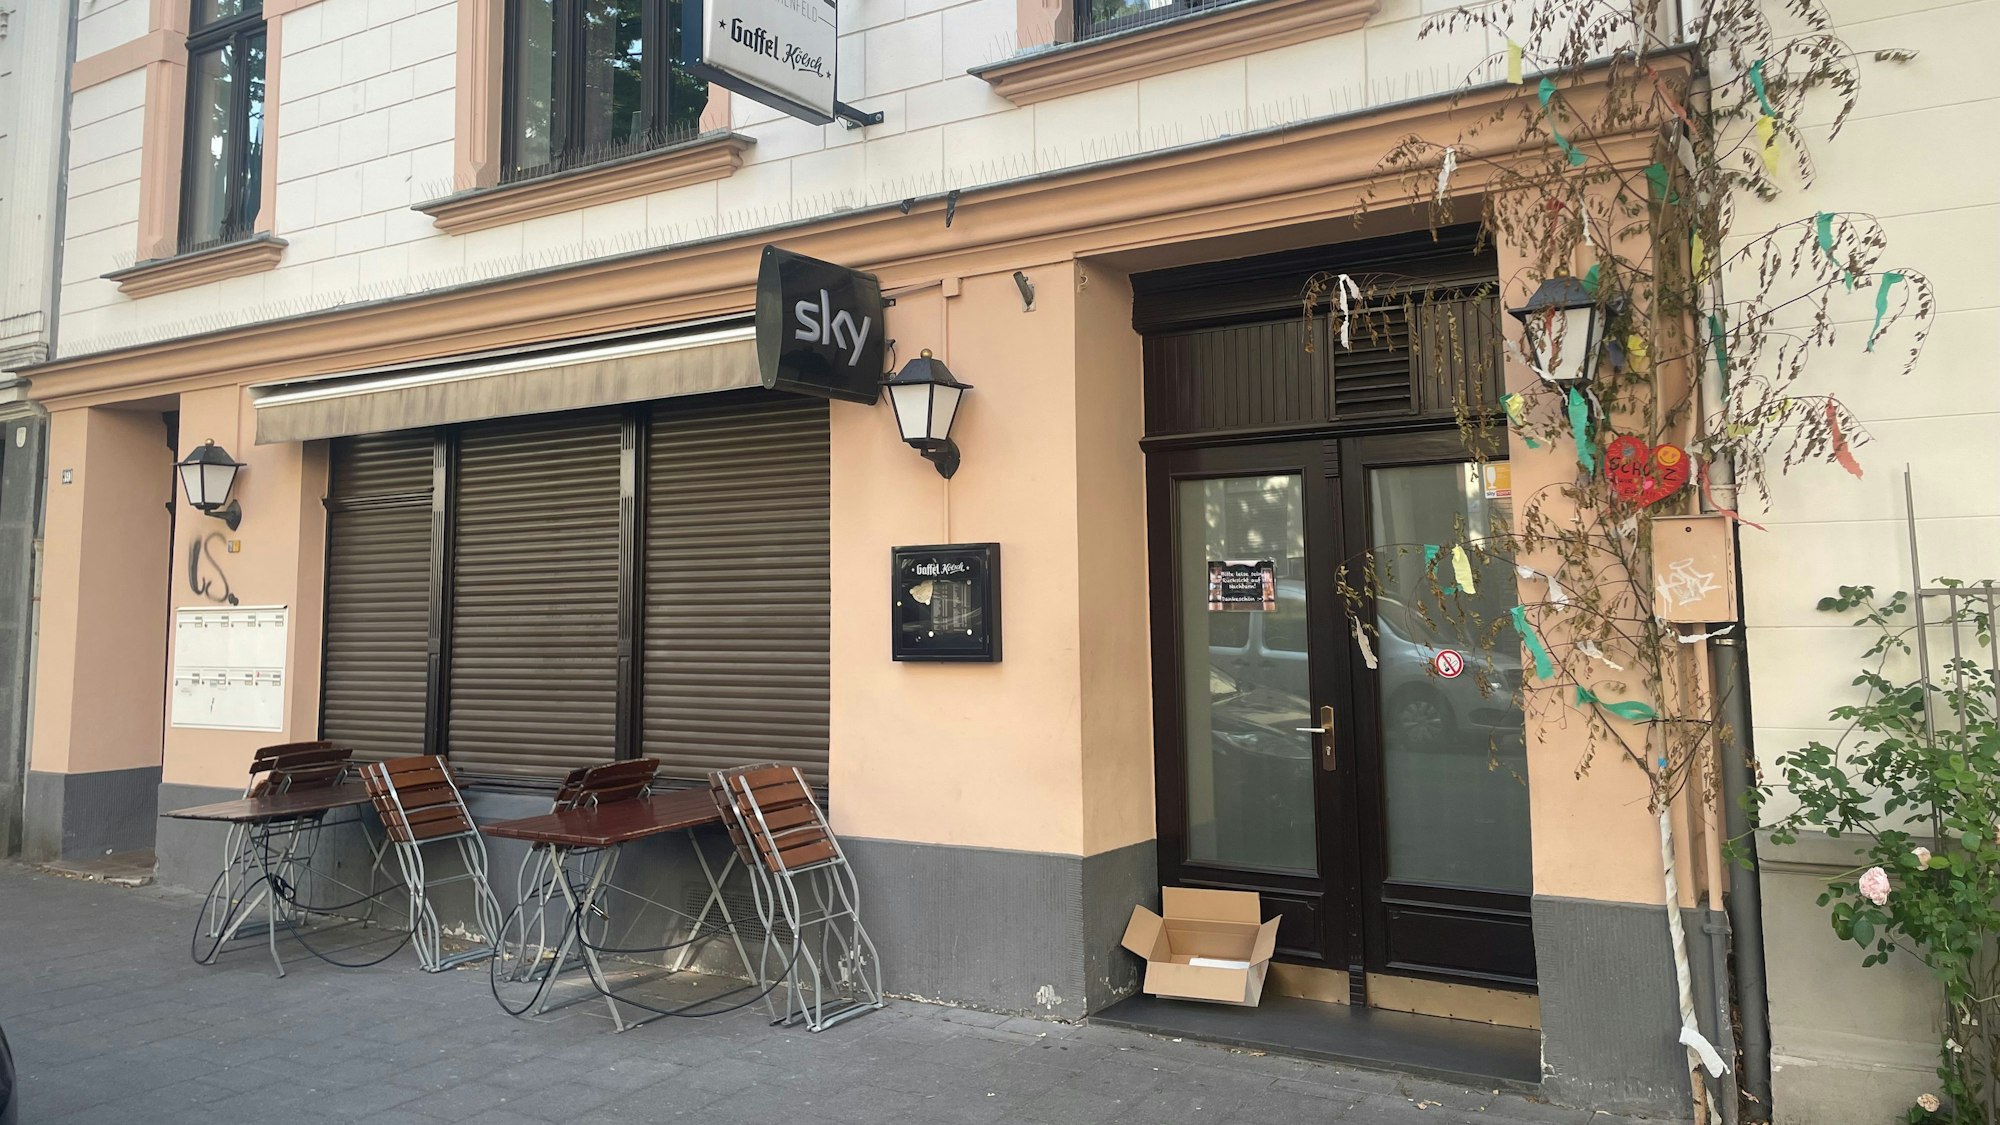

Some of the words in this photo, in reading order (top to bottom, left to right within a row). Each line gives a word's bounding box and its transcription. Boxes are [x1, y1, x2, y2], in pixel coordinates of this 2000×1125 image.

[776, 0, 818, 23] NFELD
[730, 18, 779, 61] Gaffel
[782, 43, 824, 78] Kölsch
[795, 288, 872, 367] sky
[916, 563, 940, 576] Gaffel
